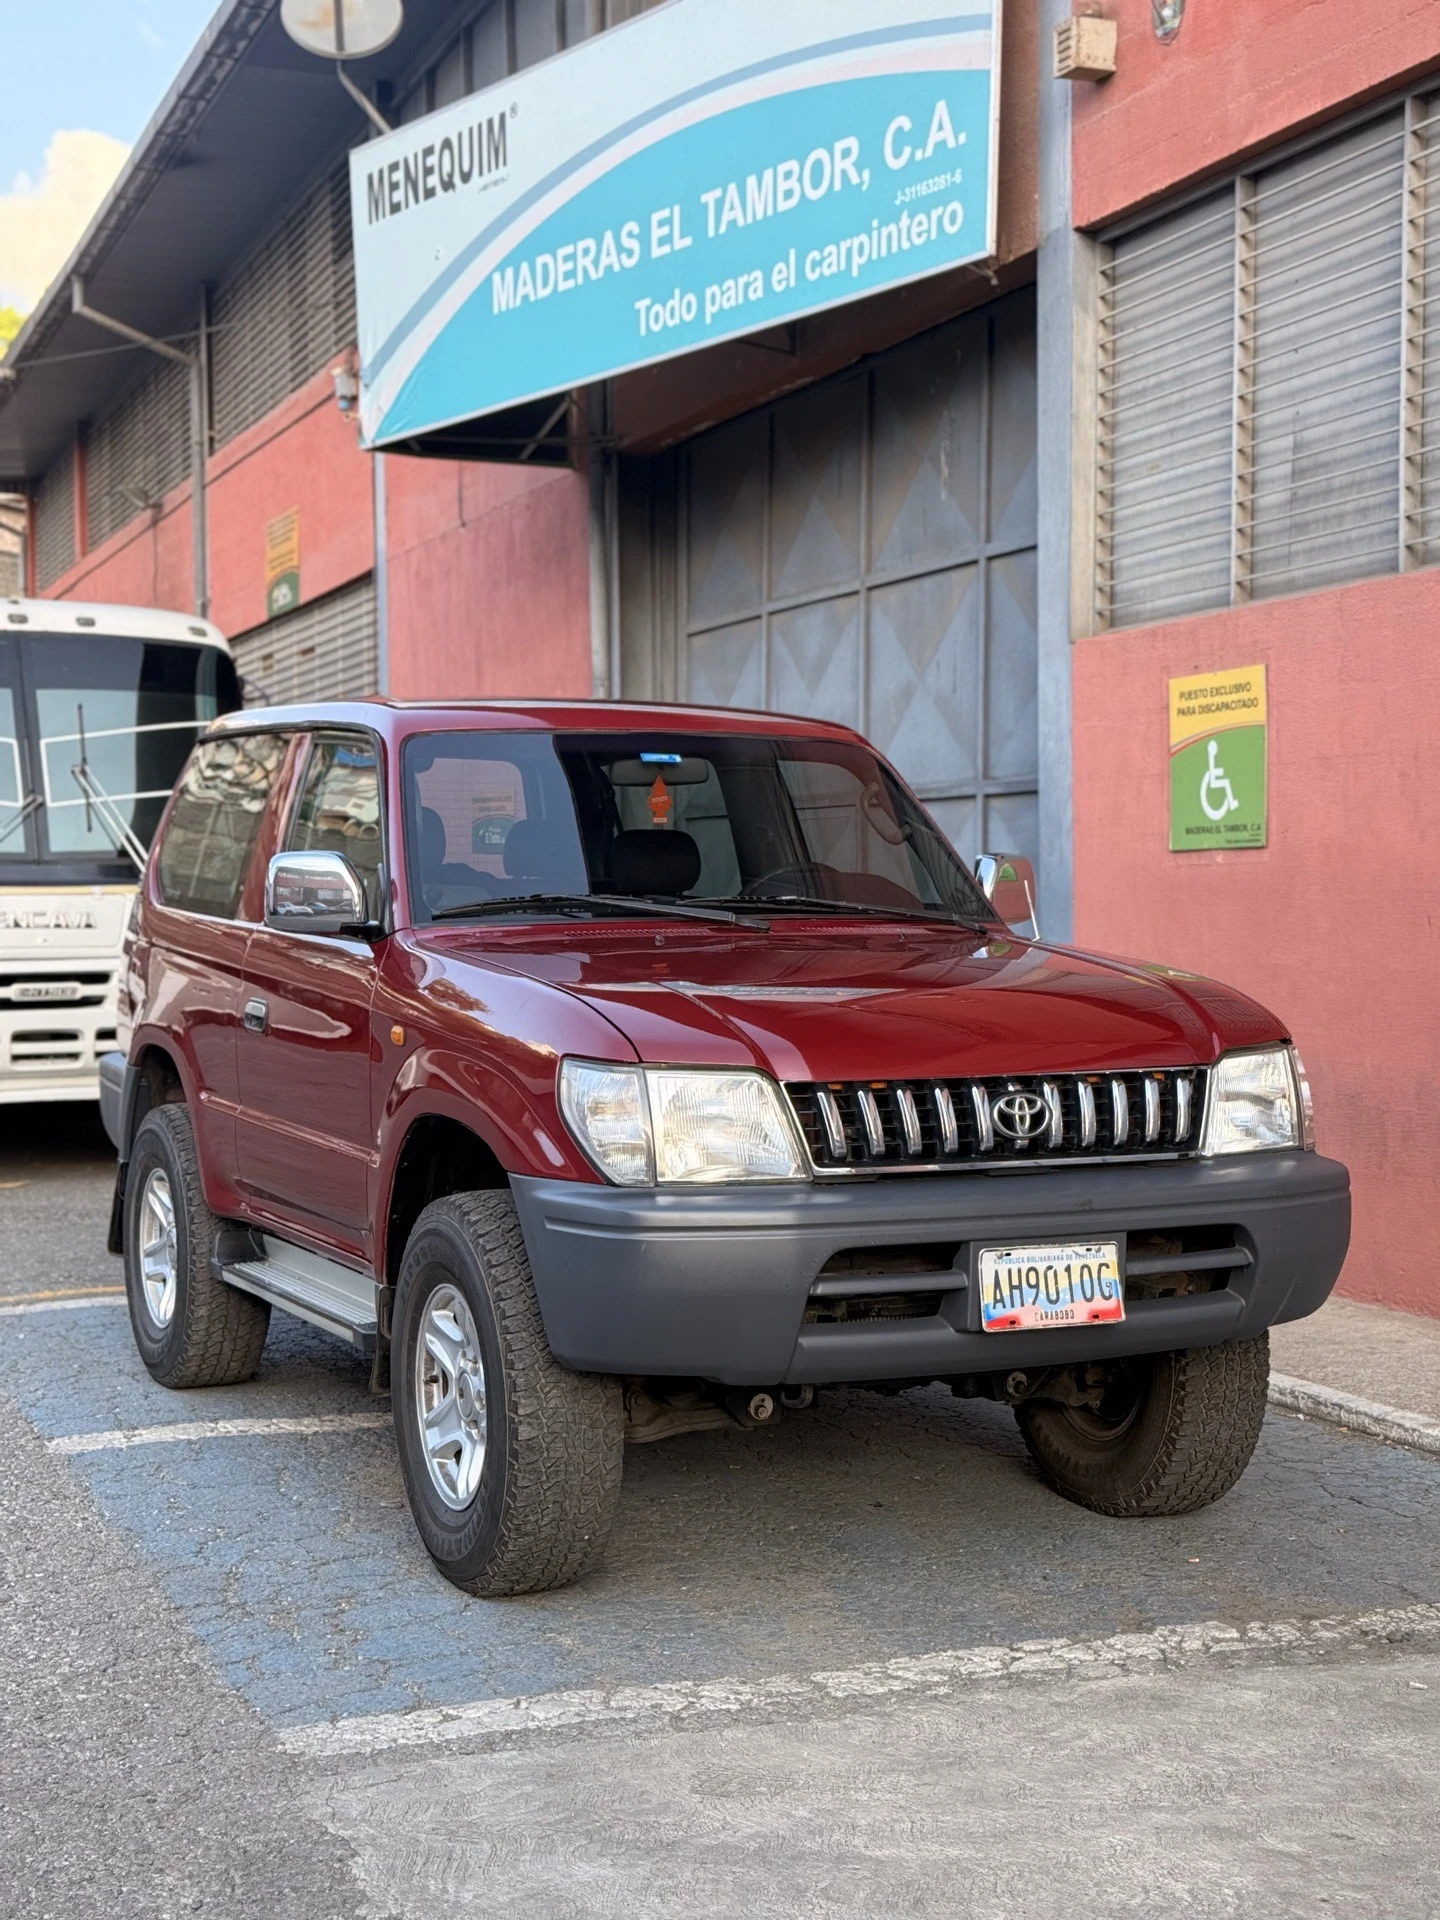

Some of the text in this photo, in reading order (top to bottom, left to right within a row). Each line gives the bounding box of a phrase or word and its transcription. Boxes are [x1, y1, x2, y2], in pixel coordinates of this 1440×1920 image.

[894, 168, 963, 206] J-31163281-6
[491, 98, 968, 315] MADERAS EL TAMBOR, C.A.
[634, 200, 965, 337] Todo para el carpintero
[1179, 681, 1252, 701] PUESTO EXCLUSIVO
[1176, 698, 1259, 717] PARA DISCAPACITADO
[1065, 1253, 1074, 1261] DE
